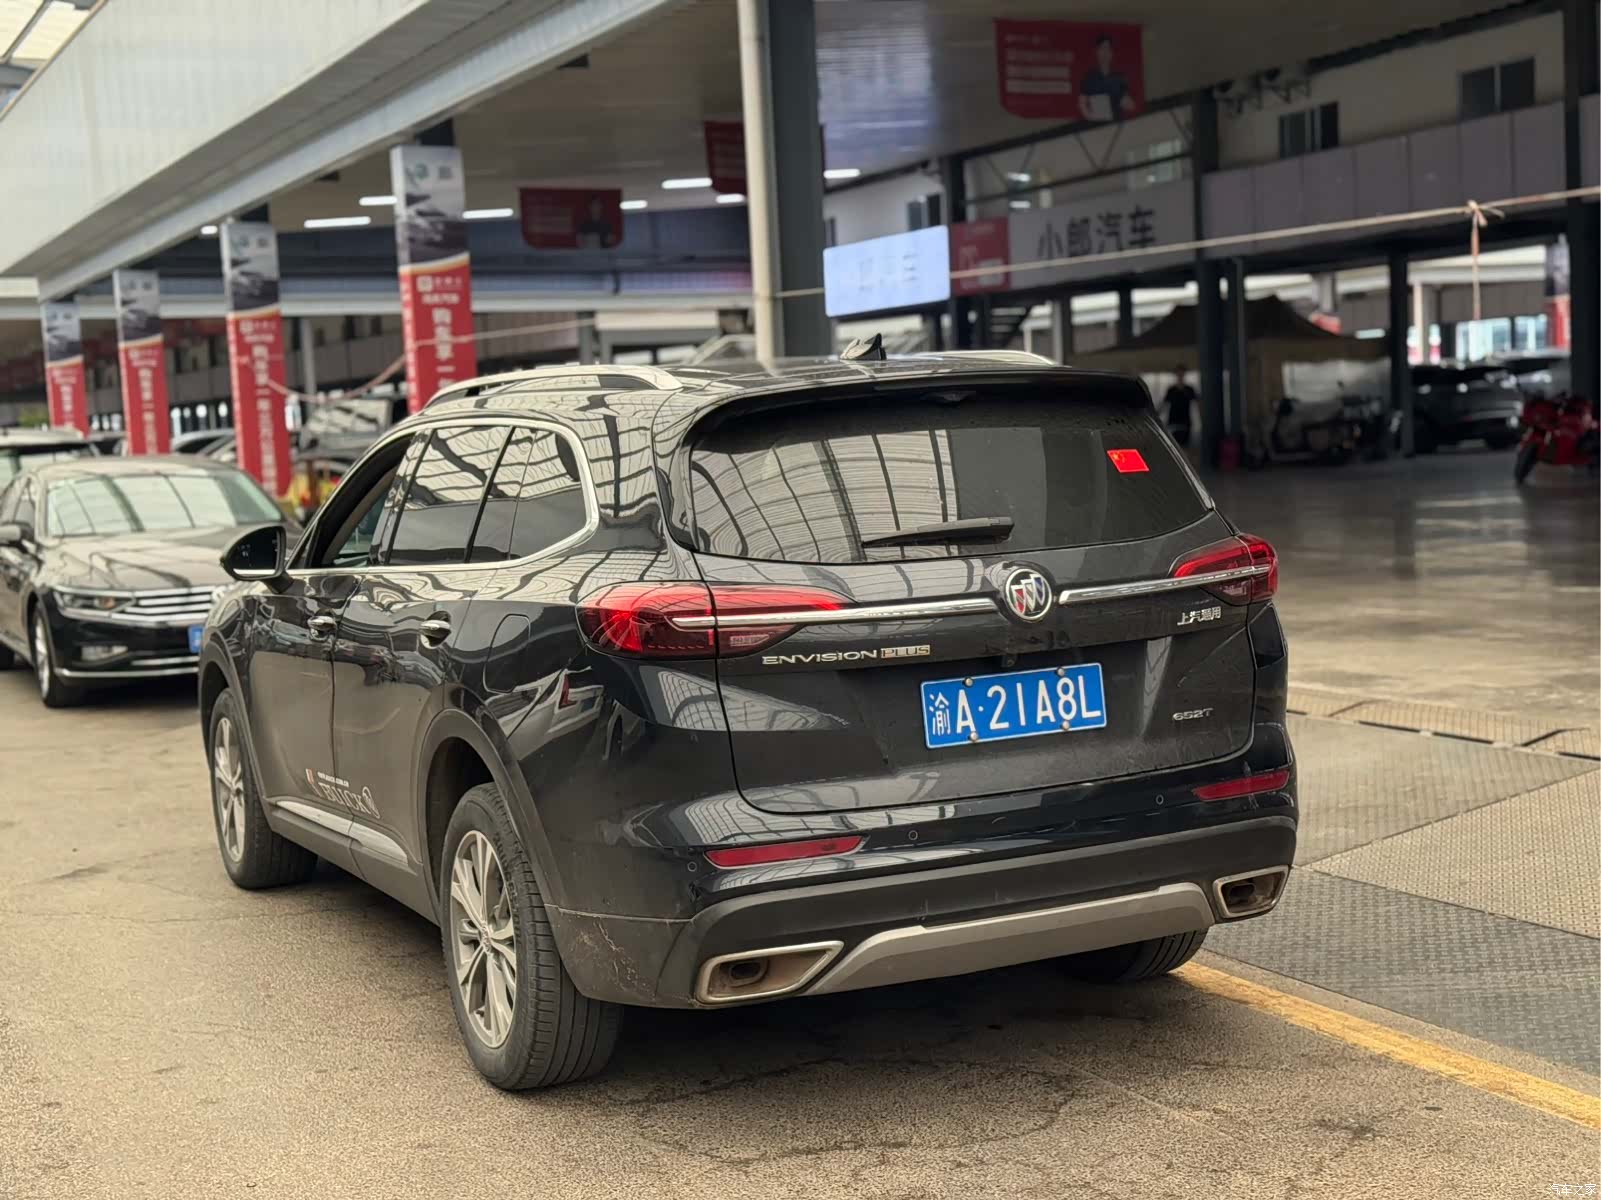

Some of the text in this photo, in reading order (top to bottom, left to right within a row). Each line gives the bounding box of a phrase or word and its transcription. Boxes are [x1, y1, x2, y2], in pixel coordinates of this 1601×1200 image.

[1176, 606, 1222, 626] 上汽通用
[762, 645, 930, 665] ENVISION PLUS
[1172, 707, 1214, 722] 652T
